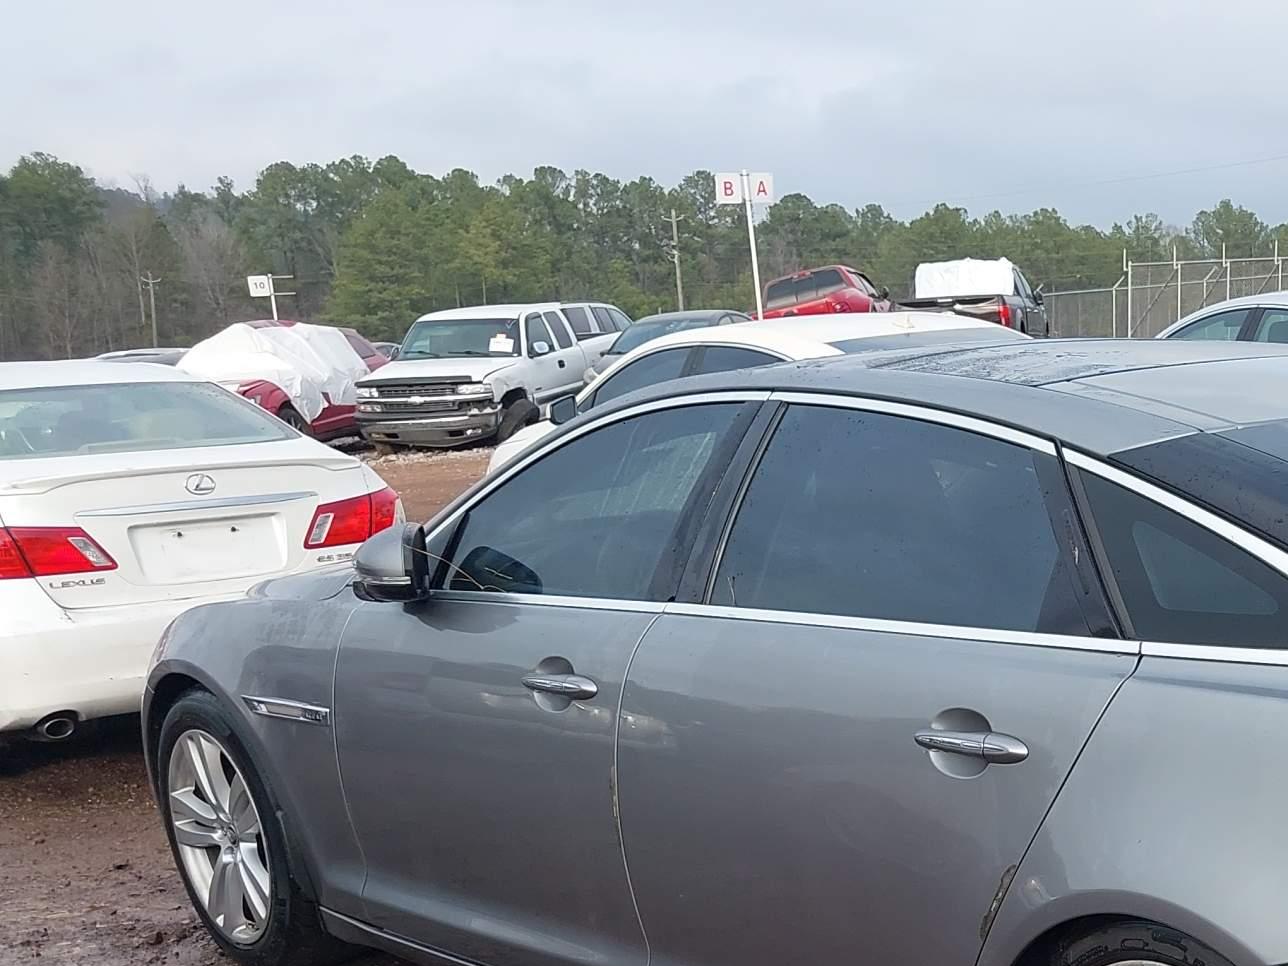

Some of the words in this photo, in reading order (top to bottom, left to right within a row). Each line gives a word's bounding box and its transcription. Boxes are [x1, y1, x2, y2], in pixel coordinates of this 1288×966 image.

[723, 180, 734, 197] B
[756, 180, 768, 196] A
[254, 281, 265, 290] 10
[48, 577, 106, 590] LEXUS
